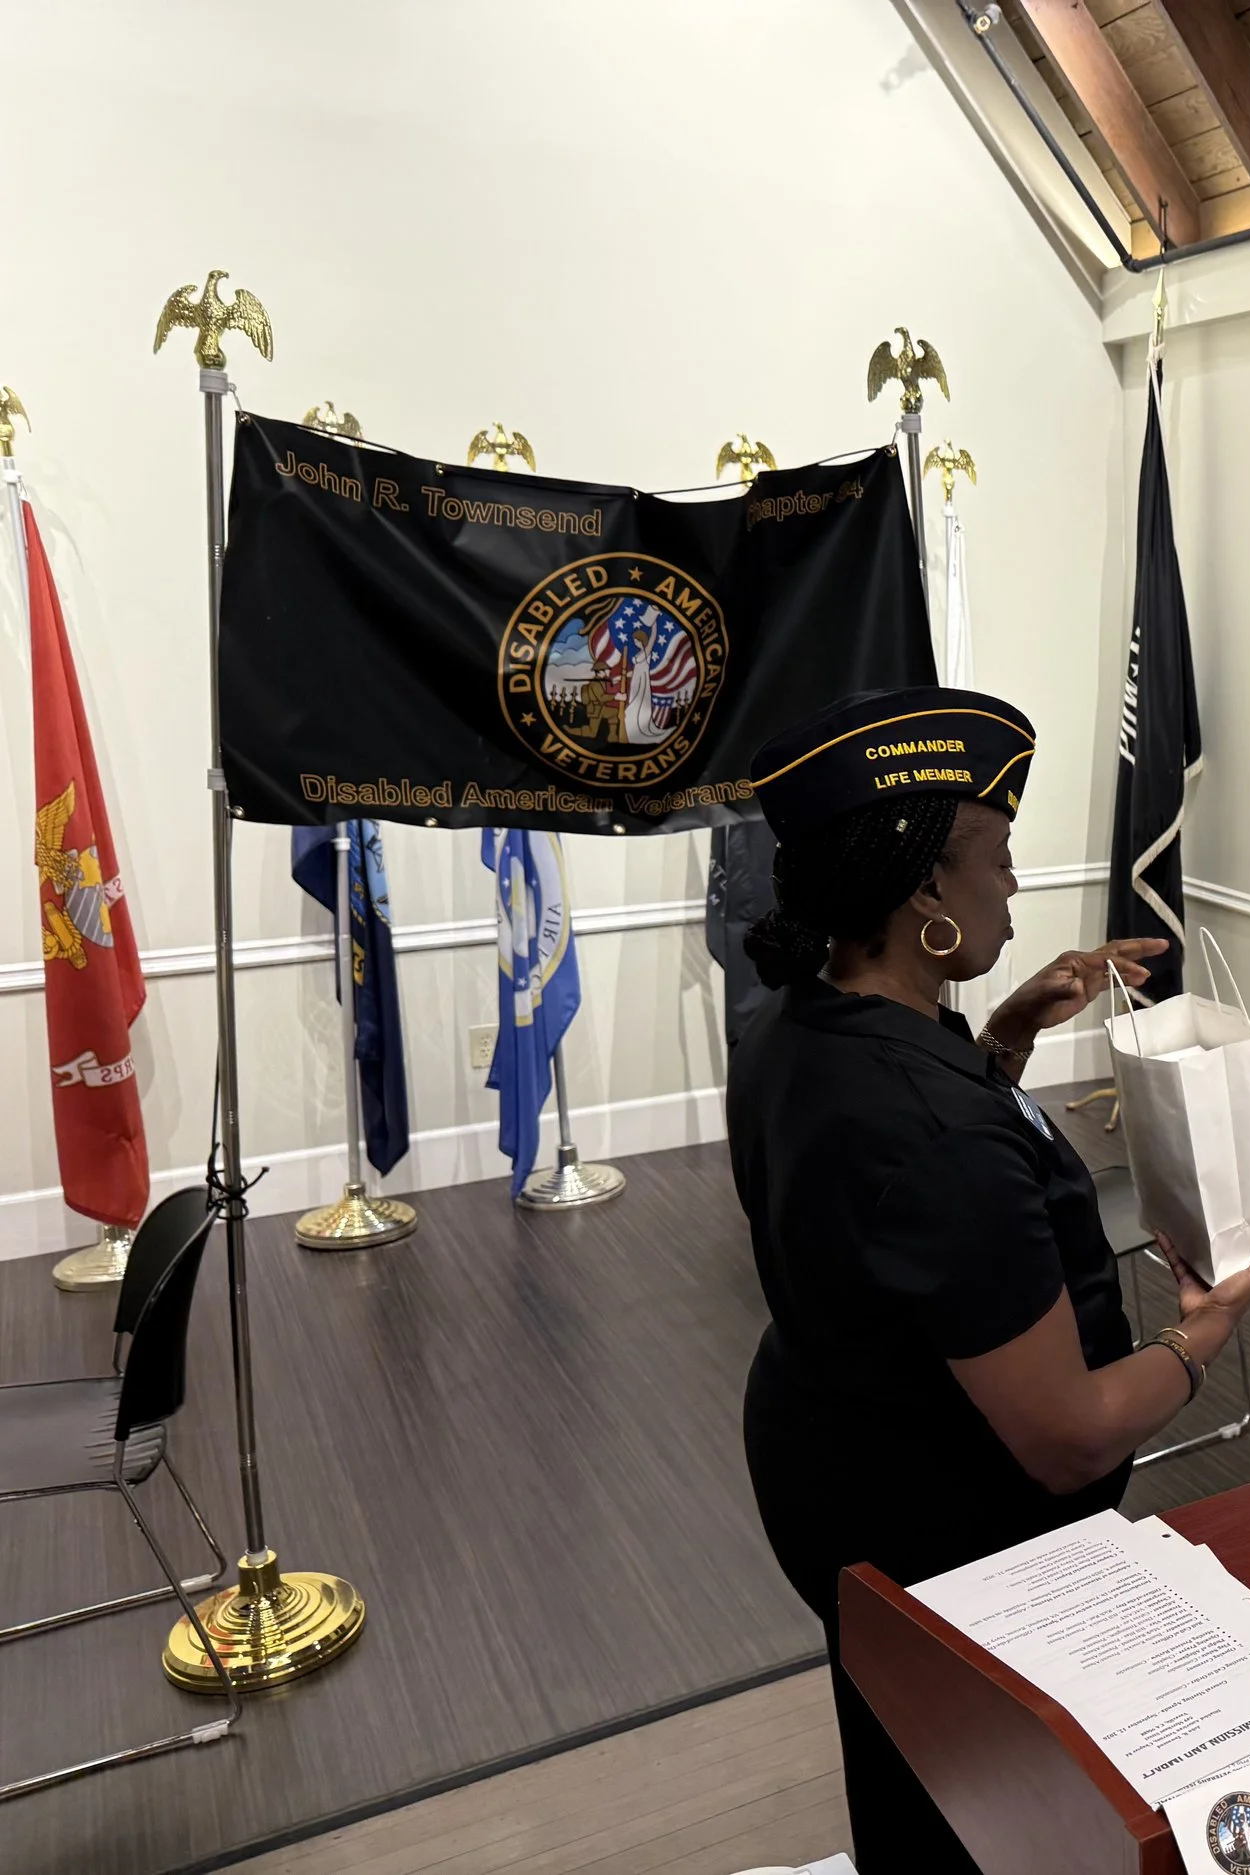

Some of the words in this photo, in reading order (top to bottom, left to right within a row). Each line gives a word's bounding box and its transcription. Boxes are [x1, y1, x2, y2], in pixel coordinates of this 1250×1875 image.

[275, 451, 361, 501] John
[373, 478, 409, 512] R.
[421, 486, 602, 536] Townsend
[509, 565, 608, 694] DISABLED
[655, 575, 723, 699] AMERICAN
[540, 734, 691, 780] VETERANS
[865, 739, 966, 760] COMMANDER
[299, 773, 452, 807] Disabled
[460, 780, 614, 813] American
[625, 778, 755, 815] Veterans
[874, 770, 910, 790] LIFE
[914, 768, 973, 784] MEMBER
[1209, 1800, 1228, 1854] DISABLED
